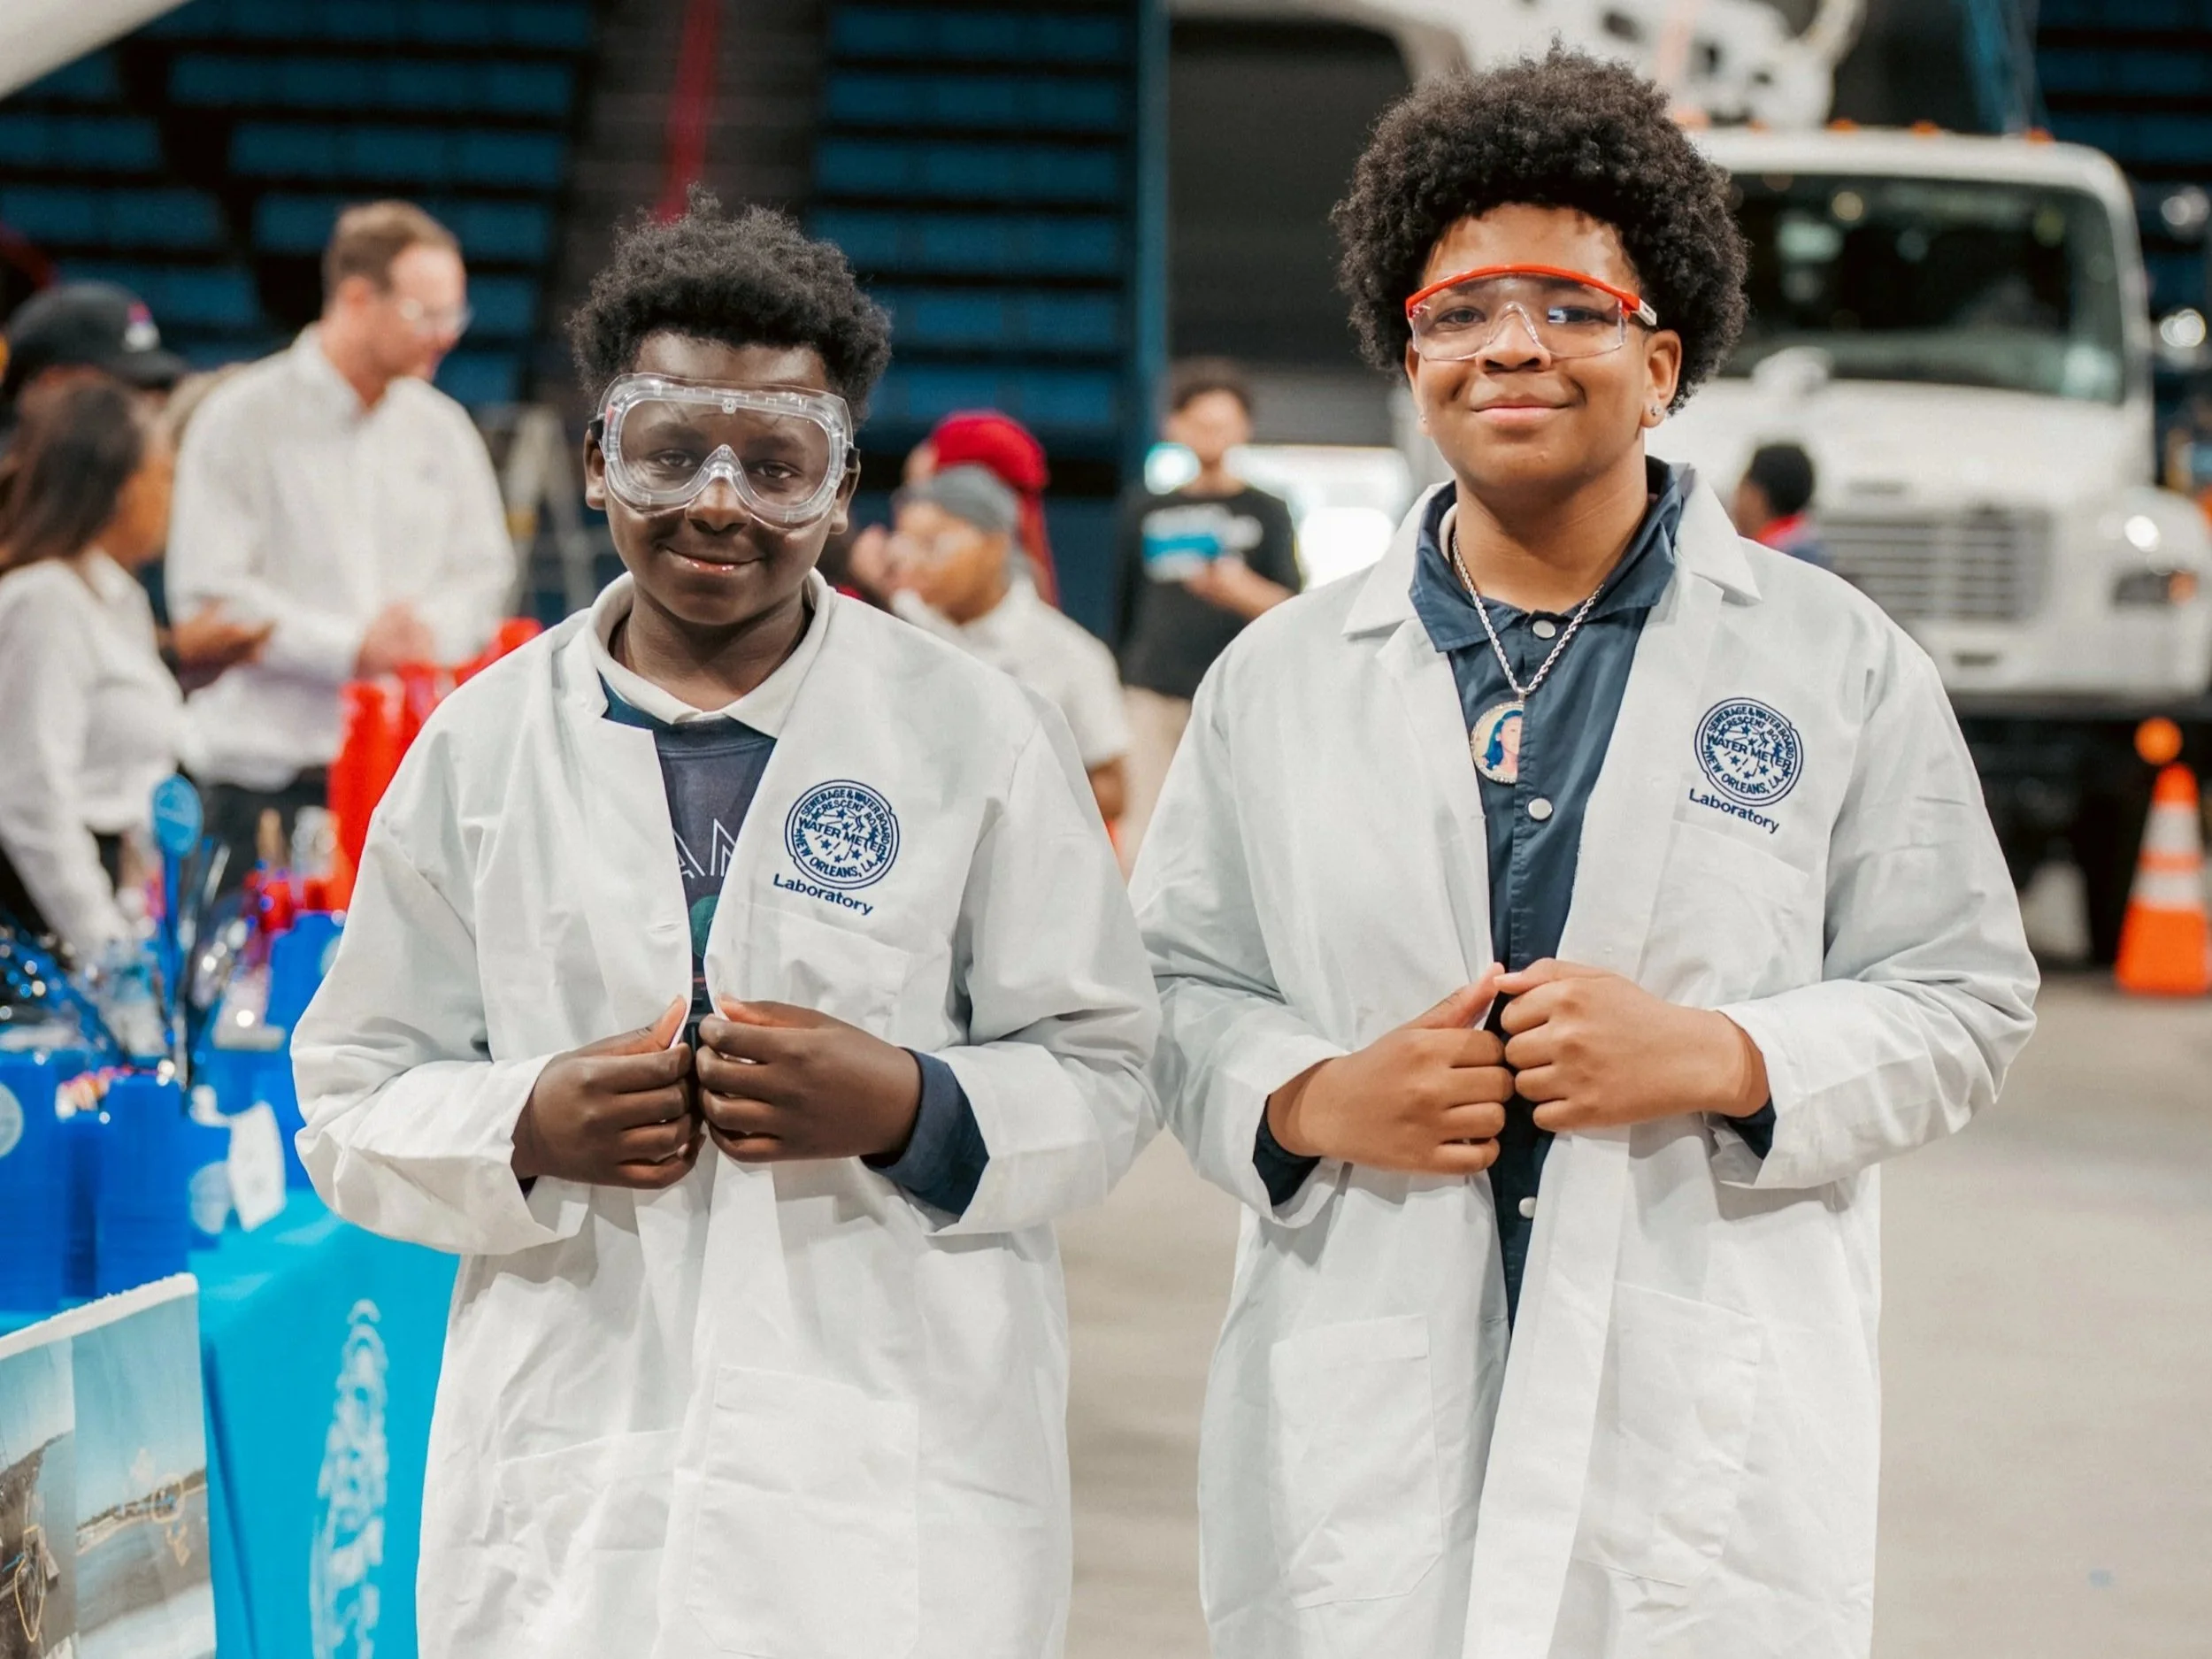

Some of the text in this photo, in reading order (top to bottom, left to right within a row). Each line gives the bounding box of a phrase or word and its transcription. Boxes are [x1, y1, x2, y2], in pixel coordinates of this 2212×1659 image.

[1708, 706, 1794, 759] SEWERAGE & WATER BOARD
[1724, 716, 1765, 733] CRESCENT
[1704, 749, 1724, 773] NEW
[1721, 773, 1770, 795] ORLEANS,
[1707, 733, 1793, 769] WATER METER
[801, 789, 890, 844] SEWERAGE & WATER BOARD
[817, 800, 864, 815] CRESCENT
[1688, 787, 1779, 834] Laboratory
[795, 833, 813, 857] NEW
[810, 856, 863, 878] ORLEANS,
[798, 816, 887, 854] WATER METER
[773, 872, 873, 916] Laboratory
